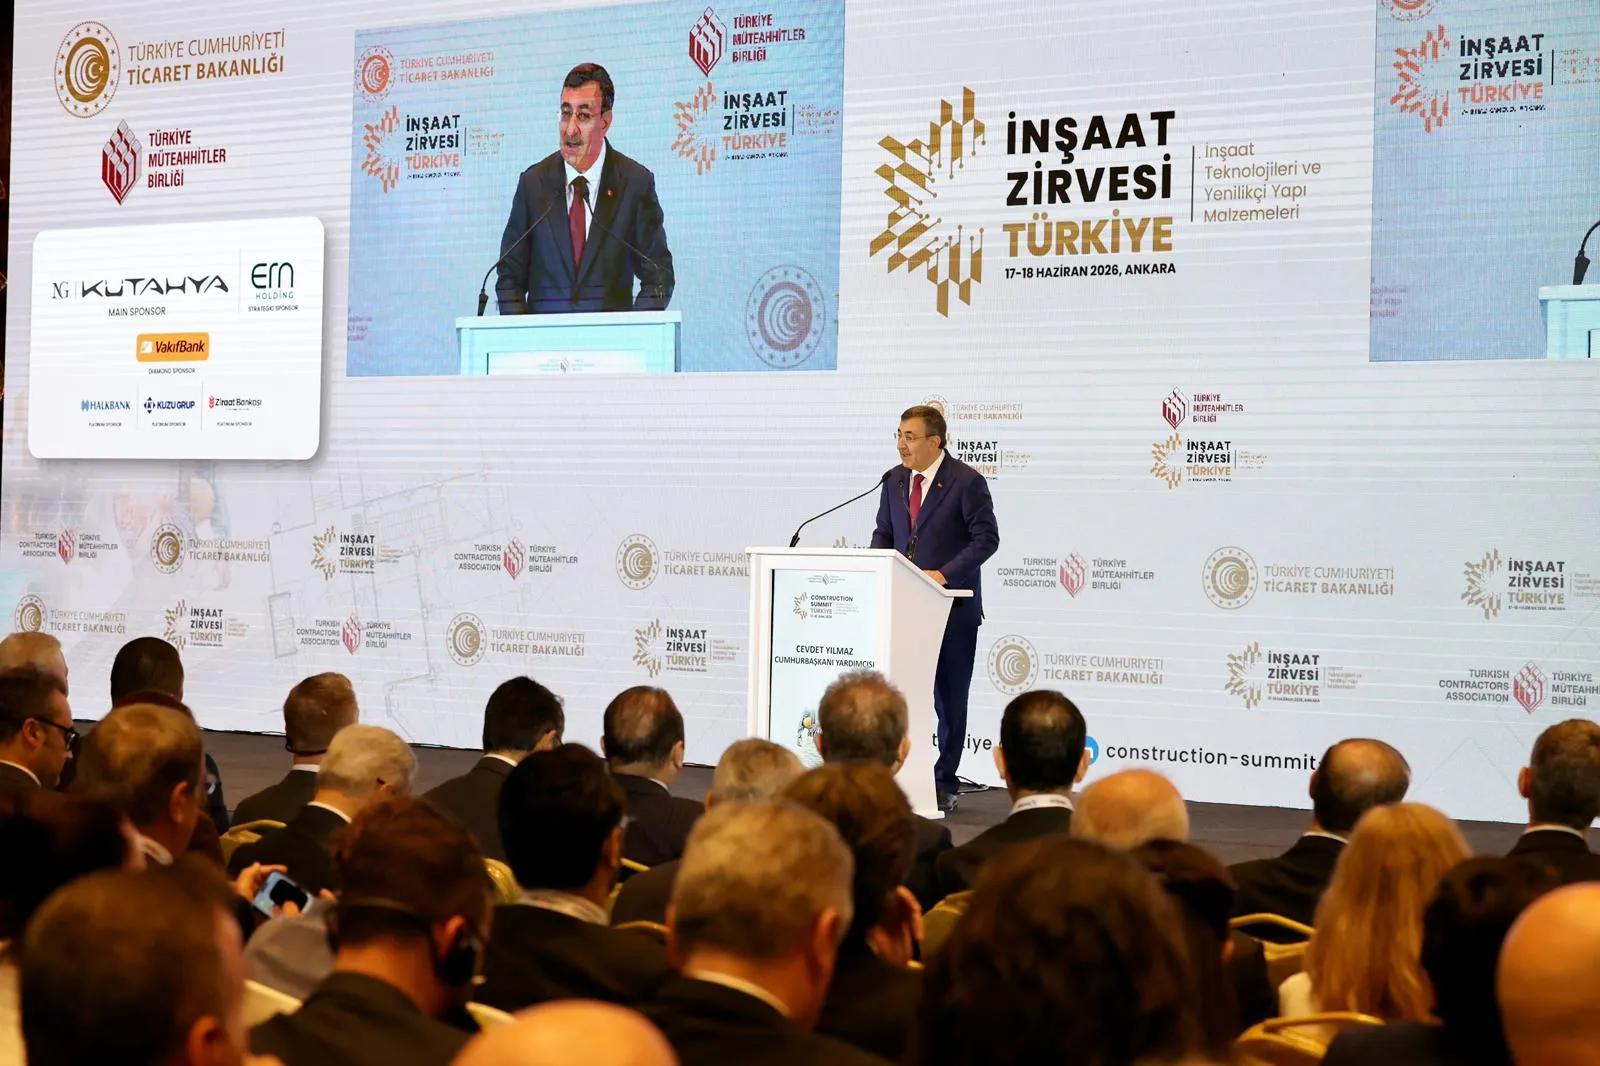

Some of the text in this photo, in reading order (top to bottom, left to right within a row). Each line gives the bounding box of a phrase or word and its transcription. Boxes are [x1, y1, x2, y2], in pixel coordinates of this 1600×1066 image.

[734, 12, 772, 29] TÜRKİYE
[733, 28, 805, 46] MÜTEAHHİTLER
[128, 28, 285, 62] TÜRKİYE CUMHURİYETİ
[1460, 34, 1544, 59] İNŞAAT
[128, 53, 284, 85] TİCARET BAKANLIĞI
[1460, 54, 1542, 80] ZİRVESİ
[1458, 80, 1544, 104] TÜRKİYE
[724, 91, 787, 112] İNŞAAT
[406, 114, 460, 134] İNŞAAT
[724, 108, 786, 130] ZİRVESİ
[149, 128, 192, 147] TÜRKİYE
[406, 130, 458, 152] ZİRVESİ
[722, 130, 787, 152] TÜRKİYE
[1007, 110, 1175, 164] İNŞAAT
[148, 146, 226, 168] MÜTEAHHİTLER
[1205, 142, 1254, 162] İnşaat
[405, 151, 459, 170] TÜRKİYE
[1205, 160, 1321, 184] Teknolojileri ve
[148, 171, 184, 188] BİRLİĞİ
[1006, 154, 1171, 206] ZİRVESİ
[1204, 184, 1306, 206] Yenilikçi Yapı
[1204, 204, 1300, 223] Malzemeleri
[1002, 209, 1173, 258] TÜRKİYE
[1005, 262, 1176, 279] 17-18 HAZİRAN 2026, ANKARA
[108, 306, 166, 316] MAIN SPONSOR
[90, 400, 130, 410] HALKBANK
[157, 400, 195, 410] KUZU GRUP
[216, 398, 235, 406] Ziraat
[958, 439, 998, 452] İNŞAAT
[1187, 438, 1231, 452] İNŞAAT
[1186, 452, 1230, 464] ZİRVESİ
[1186, 464, 1230, 476] TÜRKİYE
[340, 532, 375, 545] İNŞAAT
[340, 544, 374, 556] ZİRVESİ
[474, 544, 502, 552] TURKISH
[454, 553, 501, 562] CONTRACTORS
[1023, 558, 1056, 566] TURKISH
[1092, 558, 1126, 568] TÜRKİYE
[458, 563, 501, 572] ASSOCIATION
[664, 564, 750, 576] TİCARET BAKANL
[998, 568, 1056, 577] CONTRACTORS
[1264, 564, 1394, 580] TÜRKİYE CUMHURİYETİ
[1508, 557, 1564, 575] İNŞAAT
[1092, 569, 1154, 580] MÜTEAHHİTLER
[1508, 574, 1564, 588] ZİRVESİ
[1002, 578, 1056, 588] ASSOCIATION
[1264, 578, 1394, 596] TİCARET BAKANLIĞI
[1508, 589, 1564, 604] TÜRKİYE
[190, 606, 223, 620] İNŞAAT
[190, 618, 222, 630] ZİRVESİ
[315, 620, 340, 628] TURKISH
[296, 628, 340, 637] CONTRACTORS
[666, 626, 706, 642] İNŞAAT
[300, 638, 340, 646] ASSOCIATION
[666, 641, 706, 653] ZİRVESİ
[532, 643, 584, 656] BAKANLIĞI
[796, 645, 854, 656] CEVDET YILMAZ
[666, 654, 706, 666] TÜRKİYE
[774, 656, 874, 668] CUMHURBAŞKANI YARDIMCISI
[1044, 653, 1164, 670] TÜRKİYE CUMHURİYETİ
[1268, 650, 1320, 668] İNŞAAT
[1044, 667, 1163, 685] TİCARET BAKANLIĞI
[1268, 666, 1319, 680] ZİRVESİ
[1469, 670, 1510, 679] TURKISH
[1552, 670, 1592, 682] TÜRKİYE
[1267, 680, 1320, 696] TÜRKİYE
[1438, 680, 1510, 690] CONTRACTORS
[1445, 692, 1509, 702] ASSOCIATION
[1106, 746, 1316, 770] construction-summit
